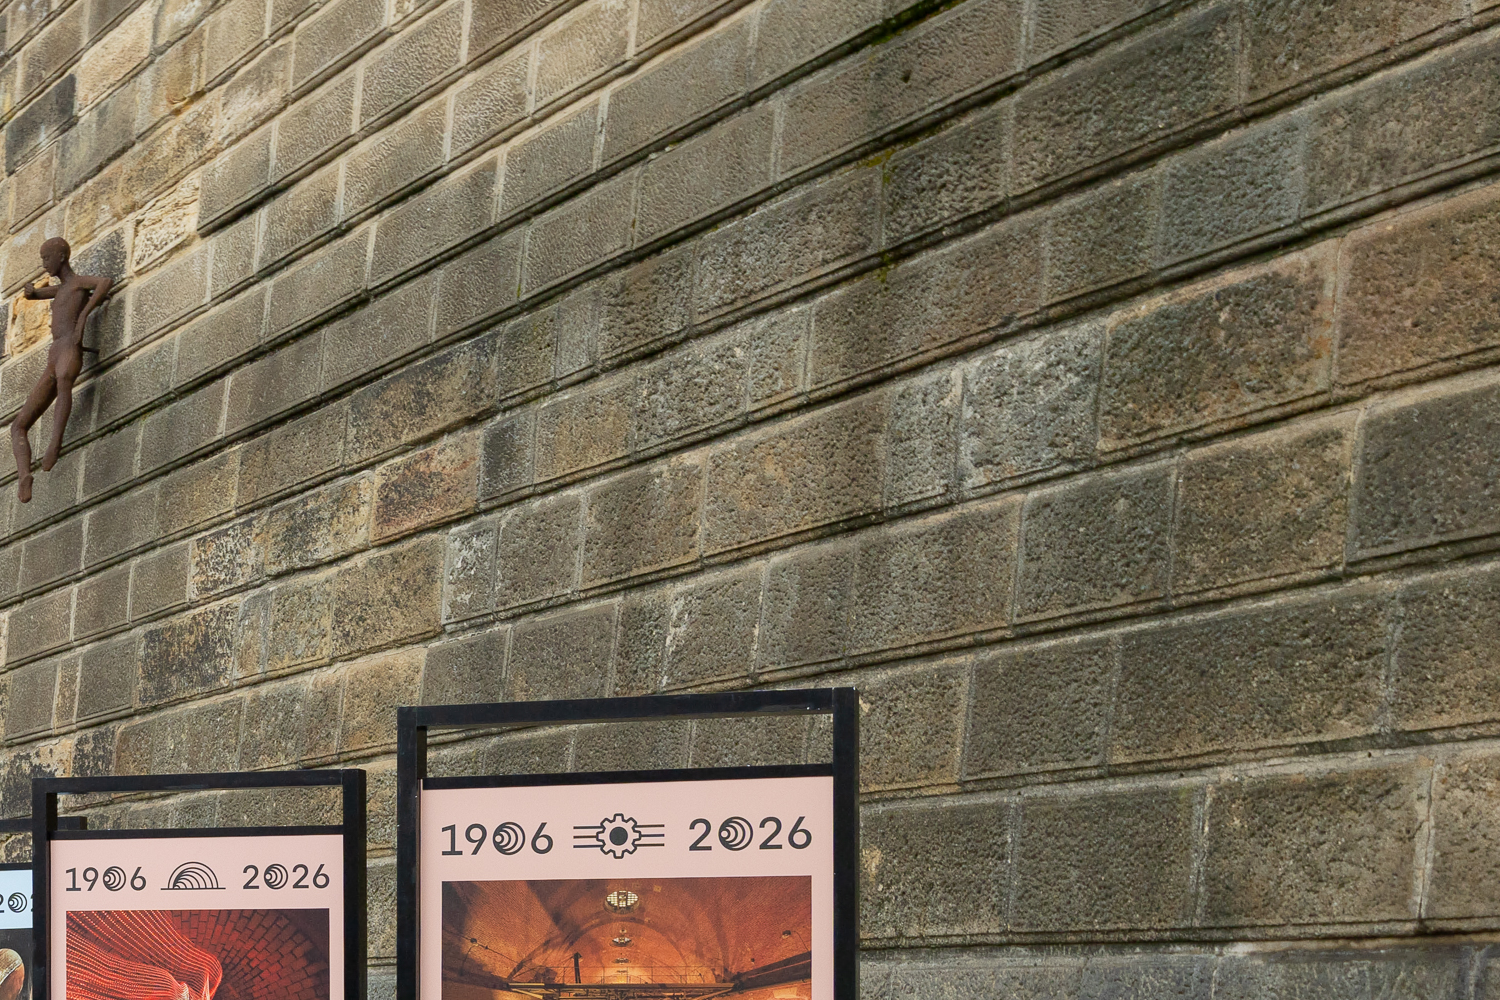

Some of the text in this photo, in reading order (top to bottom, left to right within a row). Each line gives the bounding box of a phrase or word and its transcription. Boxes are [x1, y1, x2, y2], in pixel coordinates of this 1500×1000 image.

[442, 816, 812, 855] 1906 2026
[66, 864, 330, 892] 1906 2026
